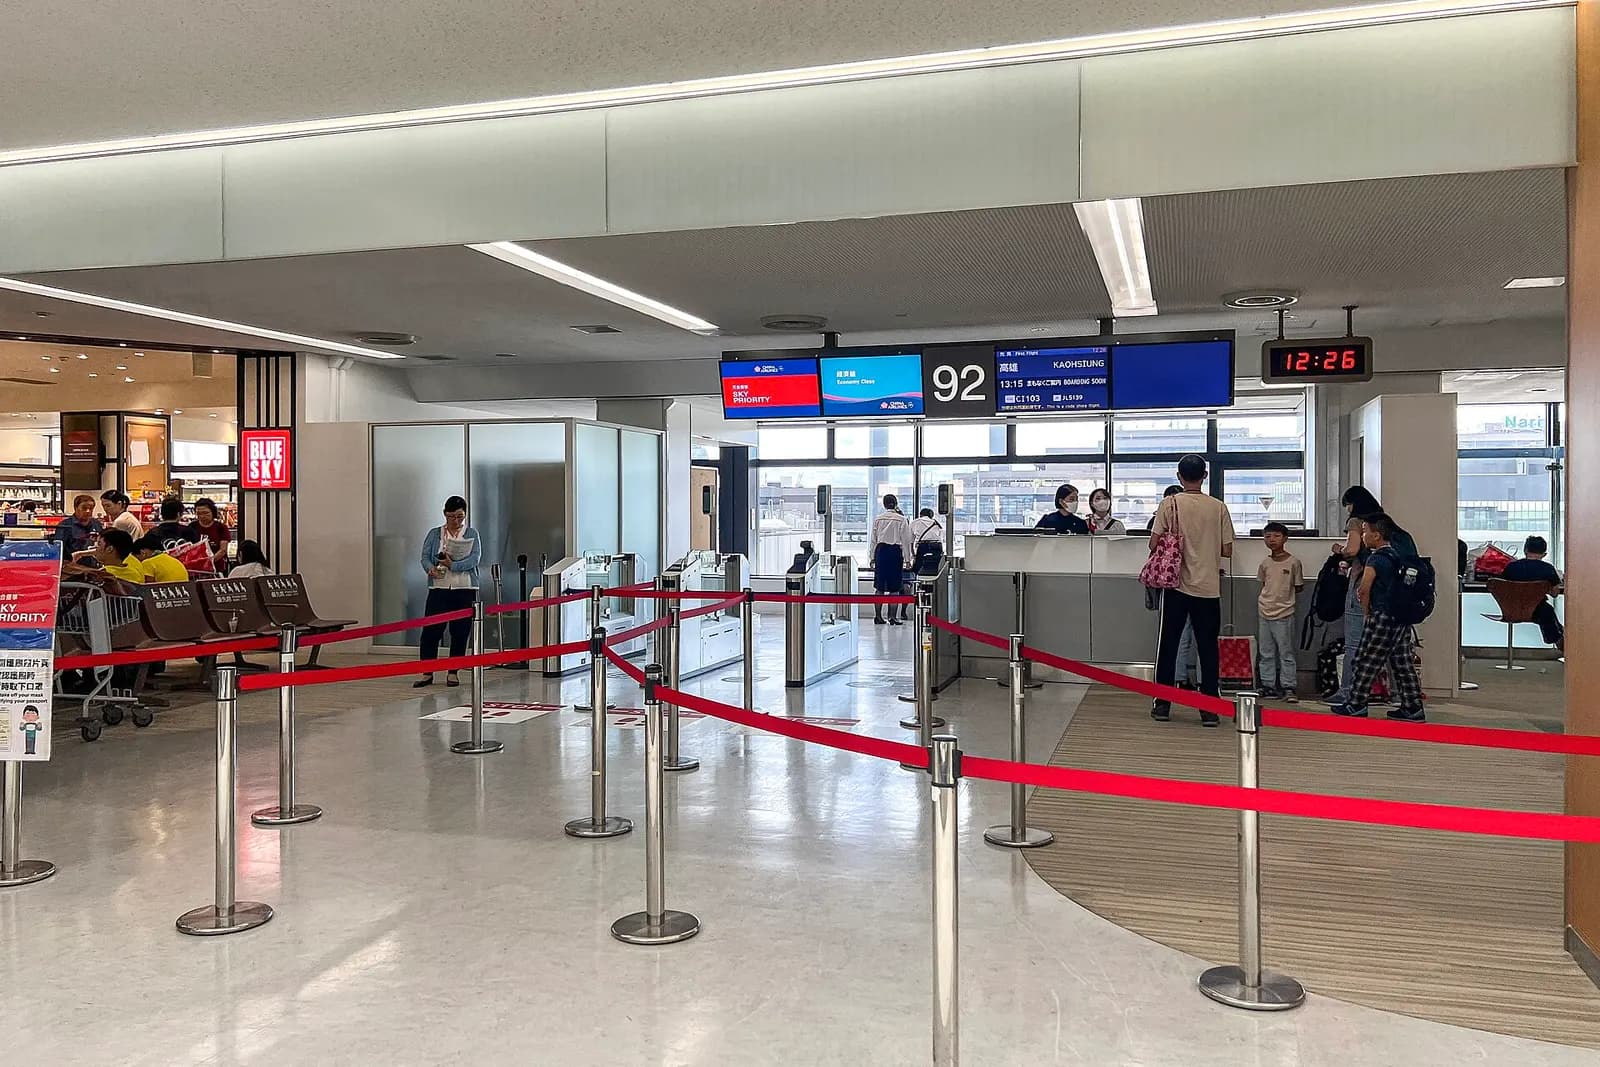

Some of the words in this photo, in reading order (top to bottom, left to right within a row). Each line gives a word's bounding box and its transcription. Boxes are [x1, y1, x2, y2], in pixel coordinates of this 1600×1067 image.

[1053, 360, 1104, 368] KAOHSIUNG
[1286, 351, 1355, 370] 12:26
[932, 364, 986, 402] 92
[1000, 380, 1023, 388] 13:15
[250, 440, 282, 460] BLUE
[250, 460, 282, 480] SKY
